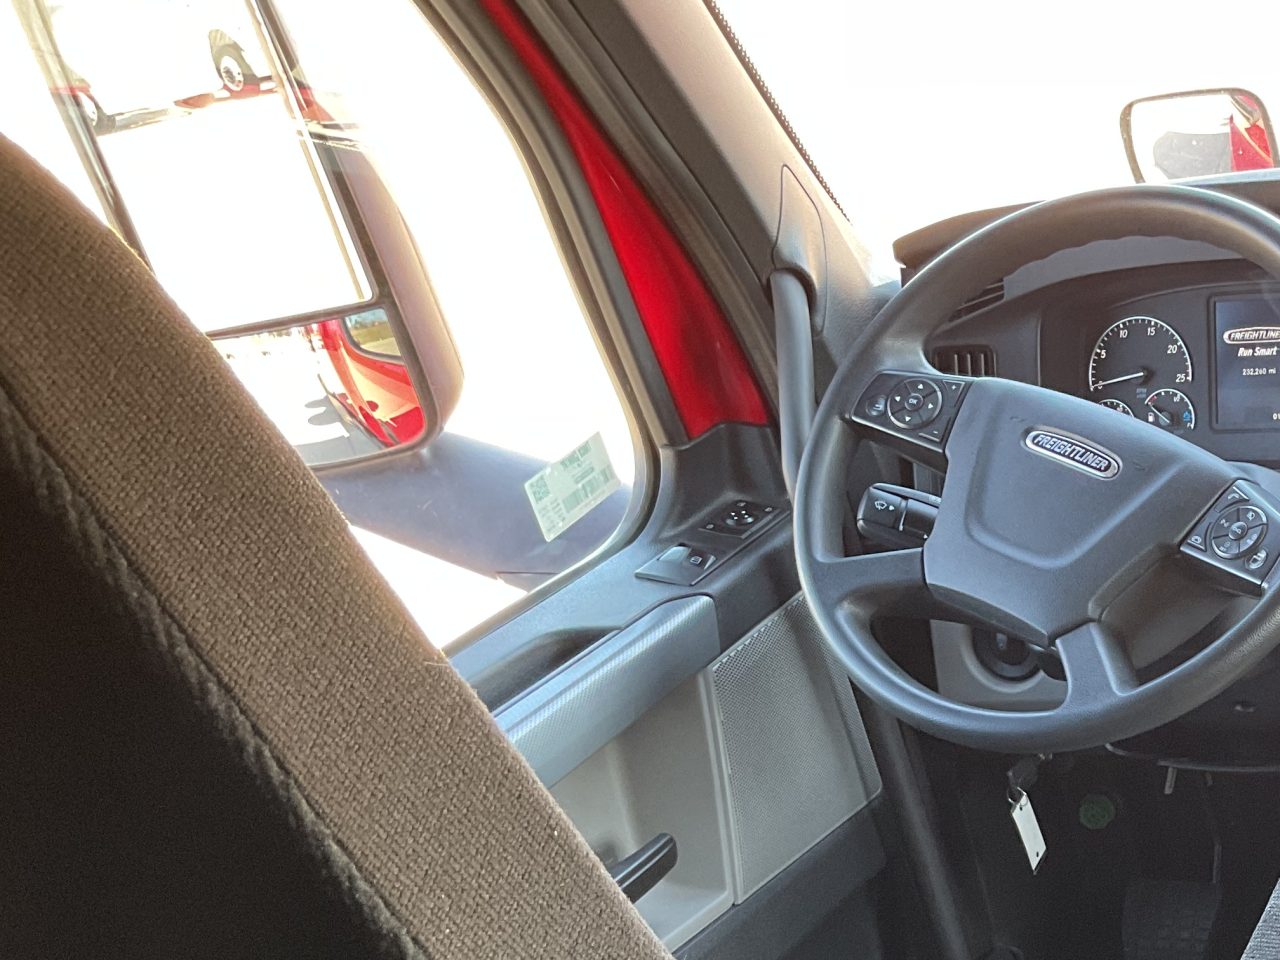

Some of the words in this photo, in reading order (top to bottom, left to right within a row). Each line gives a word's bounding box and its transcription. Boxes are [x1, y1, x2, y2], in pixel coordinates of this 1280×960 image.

[1119, 329, 1128, 339] 10
[1147, 327, 1156, 336] 15
[1100, 349, 1106, 359] 5
[1167, 344, 1178, 354] 20
[1237, 347, 1253, 357] Run
[1254, 345, 1277, 357] Smart
[1175, 373, 1186, 383] 25
[1033, 434, 1109, 471] FREIGHTLINER
